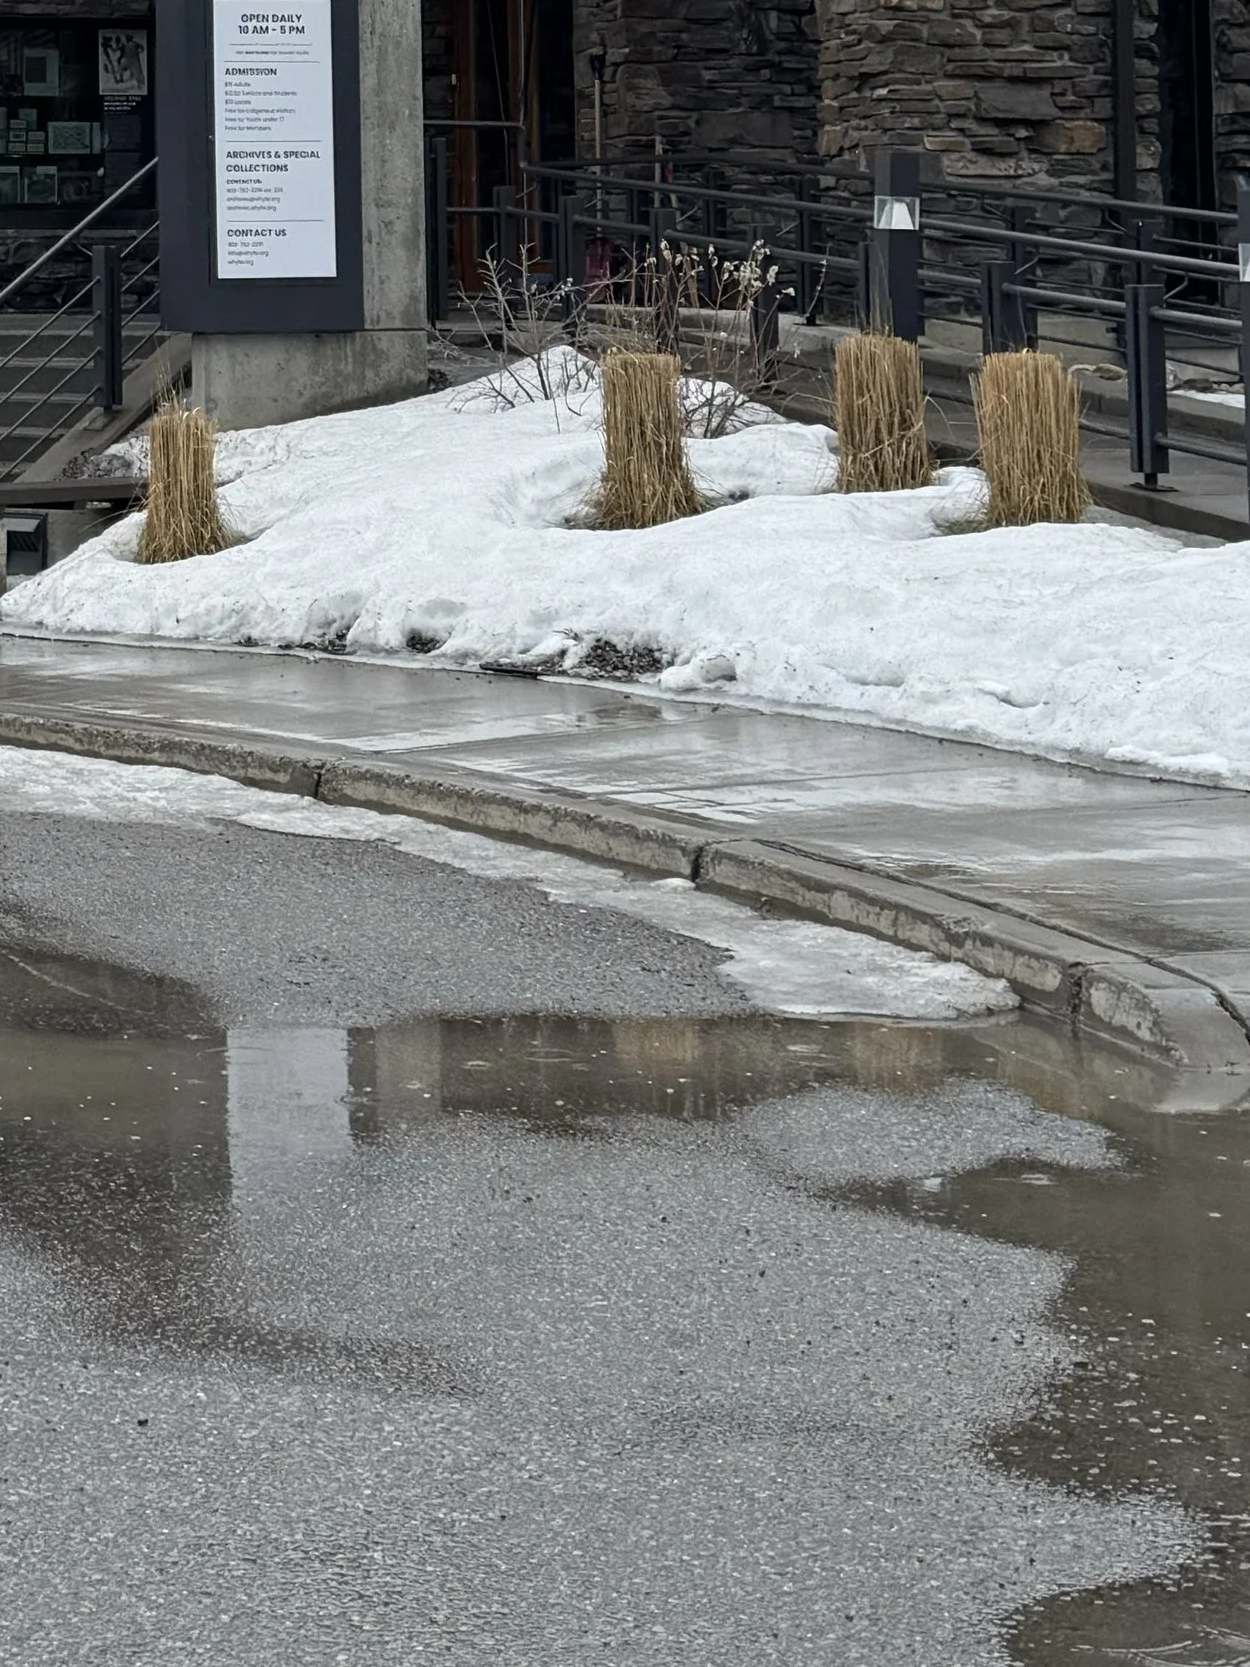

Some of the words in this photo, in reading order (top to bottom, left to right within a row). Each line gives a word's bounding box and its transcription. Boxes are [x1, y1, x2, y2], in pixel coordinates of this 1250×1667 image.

[241, 14, 269, 23] OPEN
[272, 14, 303, 23] DAILY
[238, 25, 249, 34] 10
[252, 25, 269, 34] AM
[280, 25, 286, 34] 5
[289, 25, 305, 34] PM
[225, 68, 277, 76] ADMISSION
[226, 151, 272, 159] ARCHIVES
[273, 151, 281, 159] &
[283, 151, 321, 159] SPECIAL
[226, 164, 289, 172] COLLECTIONS
[227, 229, 272, 237] CONTACT
[274, 229, 287, 237] US
